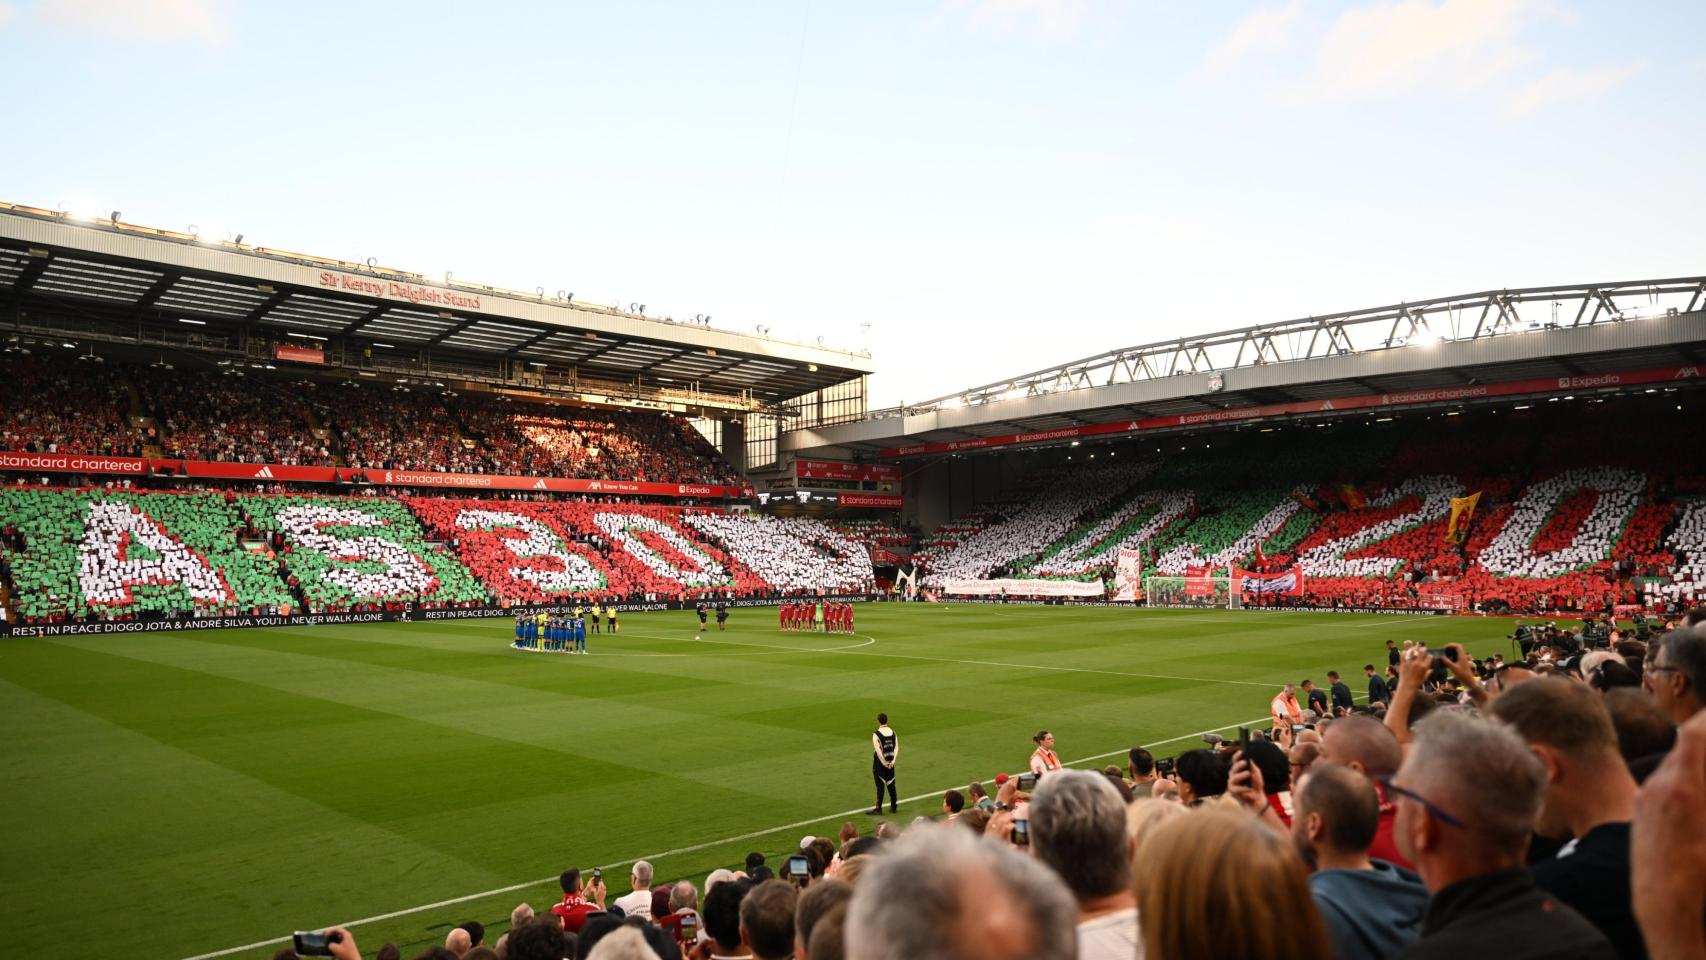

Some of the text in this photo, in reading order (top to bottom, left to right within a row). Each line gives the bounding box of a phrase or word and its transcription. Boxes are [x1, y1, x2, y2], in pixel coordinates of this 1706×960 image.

[320, 271, 482, 309] Sir Kenny Dalglish Stand
[1675, 366, 1700, 378] AXA
[1572, 373, 1620, 387] Expedia
[1391, 386, 1487, 403] standard chartered
[0, 455, 142, 472] standard chartered
[395, 473, 491, 487] standard chartered
[686, 485, 710, 495] Expedia
[846, 496, 902, 505] standard chartered
[426, 610, 447, 619] REST
[447, 610, 456, 618] IN
[457, 608, 483, 618] PEACE
[484, 606, 508, 617] DIOG
[646, 602, 668, 610] ALONE
[13, 627, 43, 636] REST
[46, 626, 60, 634] IN
[63, 624, 101, 635] PEACE
[104, 622, 143, 633] DIOGO
[144, 621, 172, 632] JOTA
[174, 622, 182, 630] &
[184, 617, 222, 630] ANDRÉ
[223, 617, 254, 628] SILVA.
[291, 615, 324, 625] NEVER
[325, 614, 351, 624] WALK
[352, 612, 383, 623] ALONE
